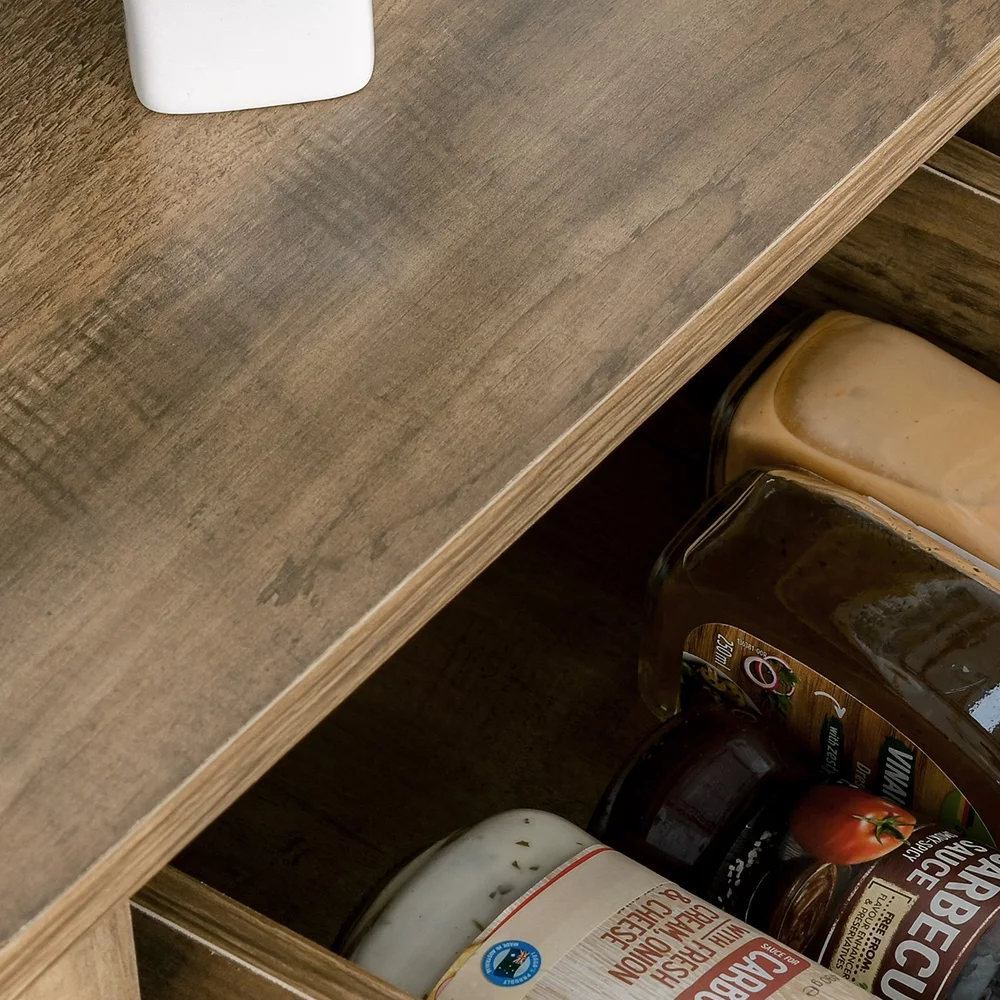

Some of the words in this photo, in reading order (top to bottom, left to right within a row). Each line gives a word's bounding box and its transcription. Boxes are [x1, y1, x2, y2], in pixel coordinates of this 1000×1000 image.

[714, 633, 734, 671] 250ml
[828, 726, 838, 750] with
[855, 761, 871, 789] Dres
[883, 746, 914, 806] VINAI
[906, 839, 987, 891] SAUCE
[658, 889, 692, 905] &
[864, 898, 873, 907] &
[865, 893, 886, 931] FLAVOUR
[600, 899, 673, 951] CHEESE
[653, 905, 720, 943] CREAM,
[708, 924, 751, 948] WITH
[836, 906, 869, 971] PRESERVATIVES
[878, 911, 895, 937] FREE
[607, 936, 672, 986] ONION
[650, 939, 717, 989] FRESH
[760, 943, 785, 959] SAUCE
[783, 954, 800, 966] FOR
[842, 930, 866, 980] ENHANCER
[861, 936, 881, 974] FROM:
